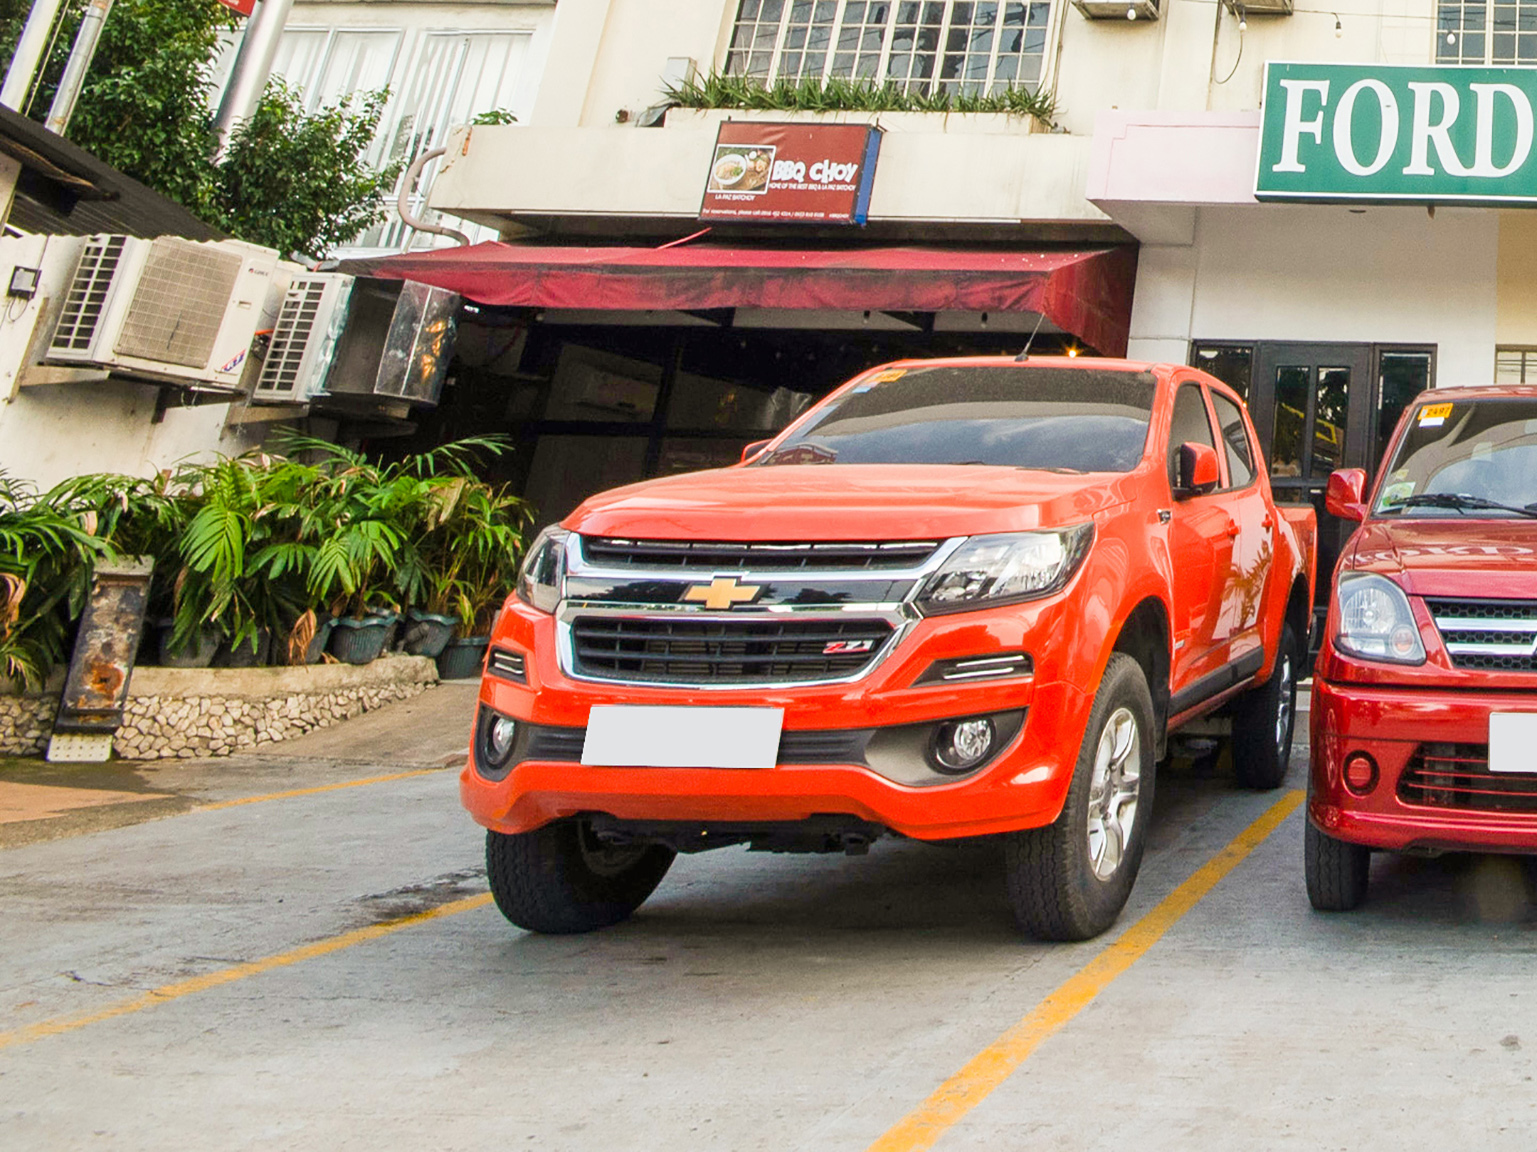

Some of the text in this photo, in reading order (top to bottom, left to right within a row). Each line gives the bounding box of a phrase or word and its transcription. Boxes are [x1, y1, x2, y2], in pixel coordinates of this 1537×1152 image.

[772, 159, 859, 184] BBQ CHOY
[822, 640, 874, 654] Z71
